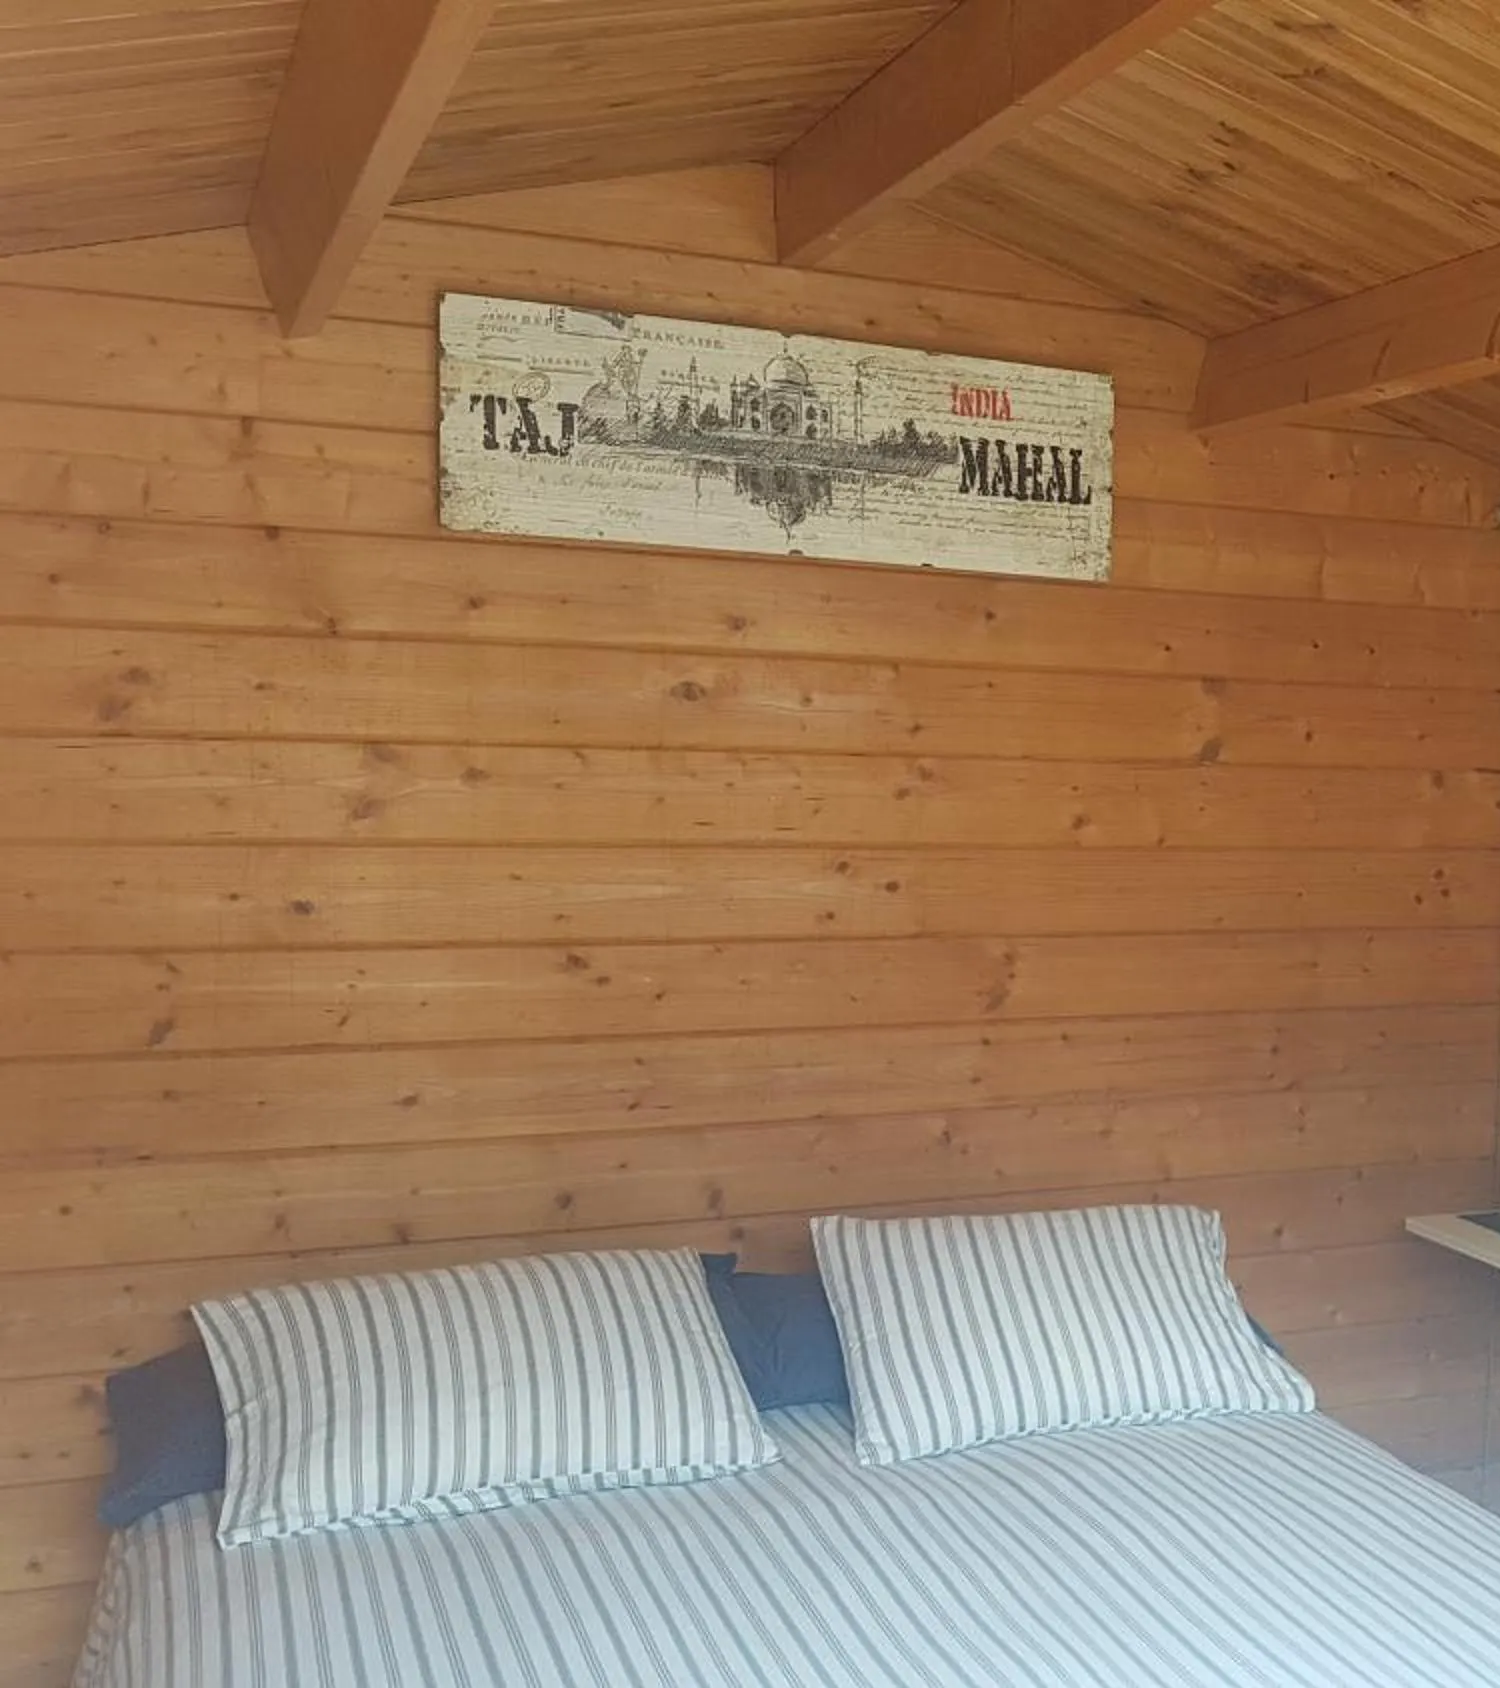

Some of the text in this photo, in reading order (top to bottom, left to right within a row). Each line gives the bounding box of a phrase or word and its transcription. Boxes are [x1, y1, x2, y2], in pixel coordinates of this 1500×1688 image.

[951, 382, 1014, 421] INDIA
[469, 394, 1092, 505] TAJ MAHAL
